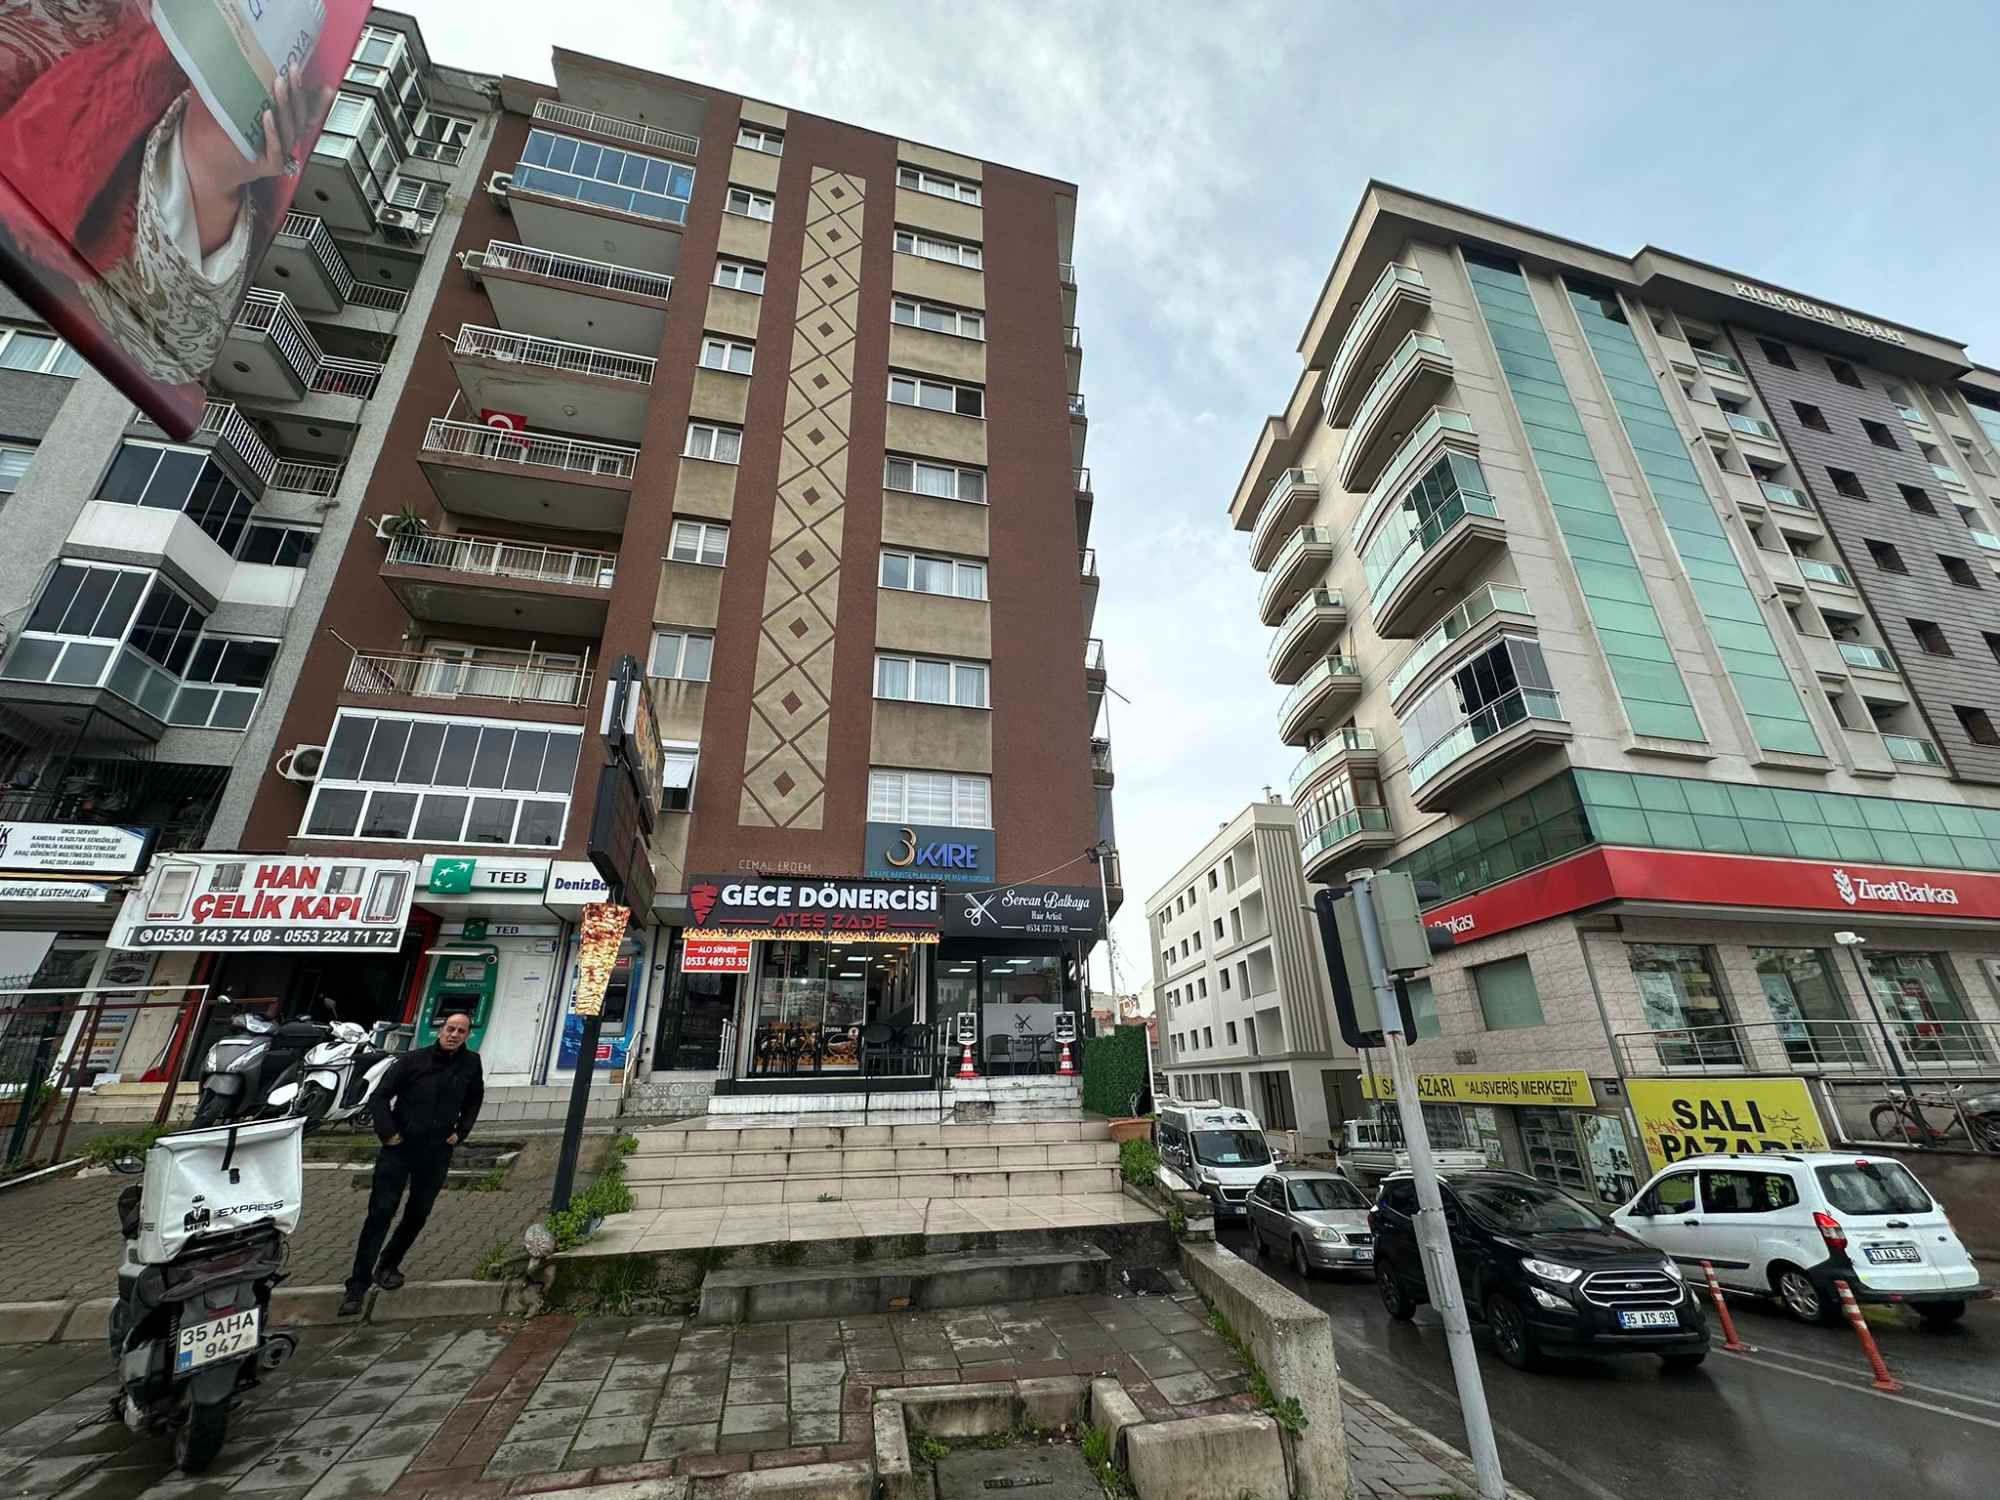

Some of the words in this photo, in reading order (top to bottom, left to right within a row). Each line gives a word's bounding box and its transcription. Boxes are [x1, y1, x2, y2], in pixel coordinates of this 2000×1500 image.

[254, 865, 320, 889] HAN
[487, 871, 528, 884] TEB
[721, 884, 792, 907] GECE
[798, 882, 938, 911] DÖNERCİSİ
[1002, 889, 1041, 907] Sercan
[1042, 890, 1091, 911] Balkaya
[1853, 878, 1903, 901] Ziraat
[1897, 881, 1959, 904] Bankası
[192, 890, 287, 924] ÇELİK
[289, 896, 362, 920] KAPI
[1031, 910, 1044, 920] Hair
[495, 926, 520, 935] TEB
[831, 913, 889, 929] ZADE
[154, 930, 194, 943] 0530
[199, 930, 226, 943] 143
[231, 930, 250, 943] 74
[252, 931, 271, 943] 08
[284, 931, 318, 944] 0553
[321, 931, 349, 944] 224
[353, 932, 370, 944] 71
[375, 932, 393, 944] 72
[686, 957, 706, 966] 0533
[707, 957, 724, 966] 489
[725, 957, 736, 966] 53
[1417, 1078, 1457, 1097] AZARI
[1672, 1098, 1766, 1134] SALI
[216, 1199, 284, 1218] EXPRESS
[184, 1221, 211, 1233] MEN
[1624, 1313, 1637, 1324] 35
[1640, 1312, 1657, 1324] ATS
[1659, 1311, 1677, 1323] 993
[183, 1325, 208, 1346] 35
[213, 1312, 255, 1338] AHA
[204, 1333, 243, 1359] 947
